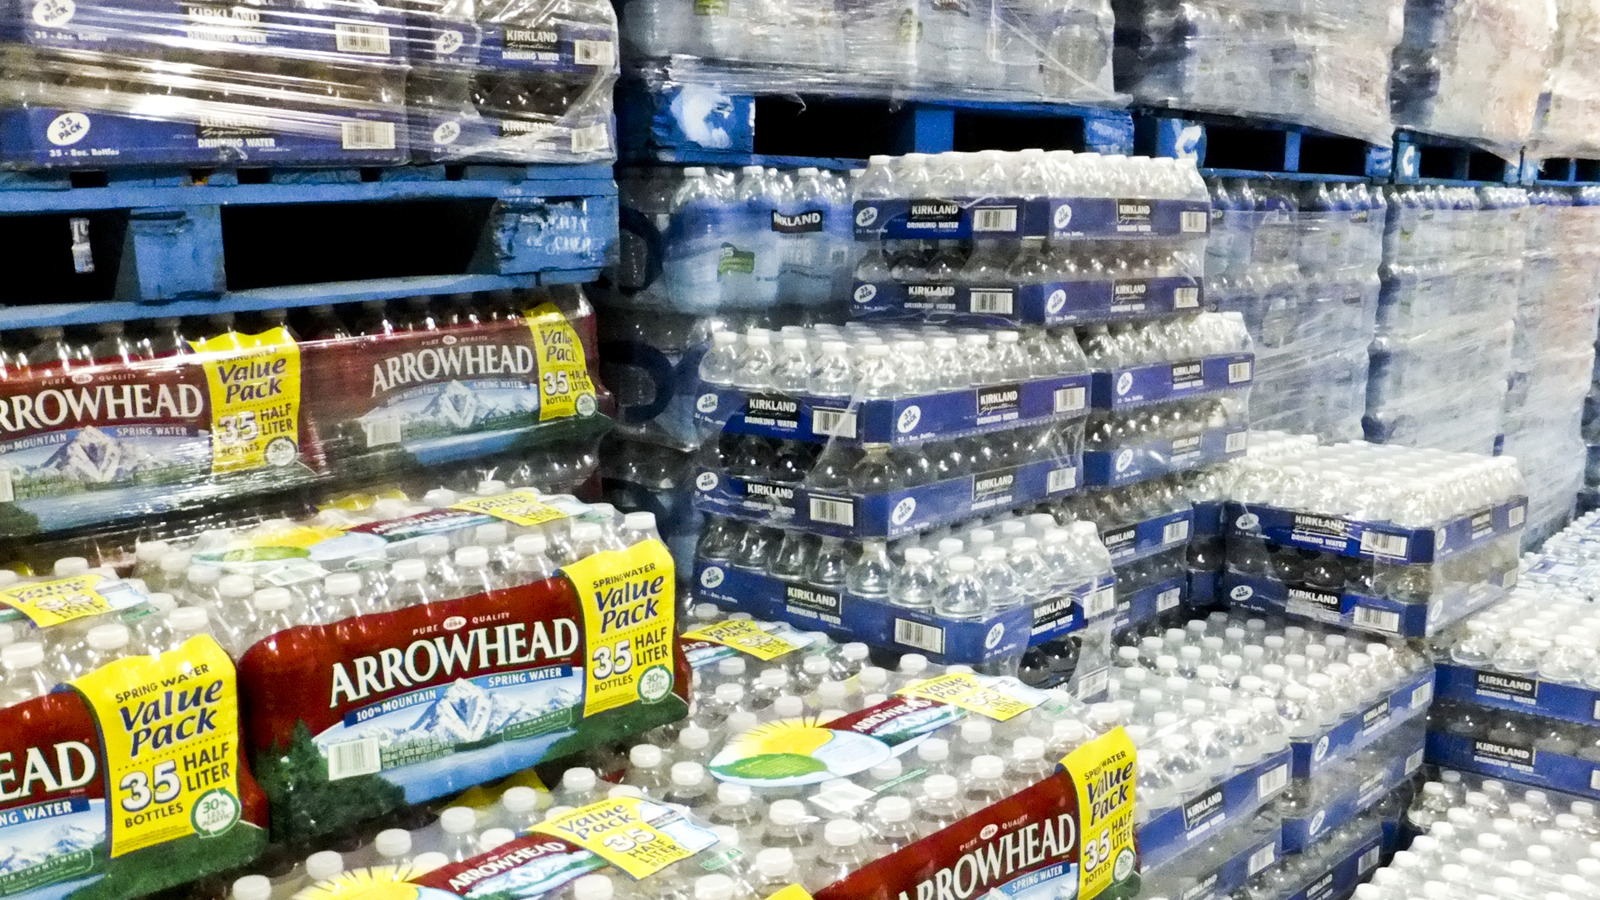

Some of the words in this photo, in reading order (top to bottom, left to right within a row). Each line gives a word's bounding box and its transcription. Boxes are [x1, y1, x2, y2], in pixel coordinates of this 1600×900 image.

[507, 29, 558, 43] KIRKLAND
[502, 51, 536, 61] DRINKING
[538, 52, 560, 62] WATER
[58, 116, 73, 129] 35
[58, 121, 83, 141] PACK
[49, 149, 62, 157] 35
[197, 137, 244, 149] DRINKING
[246, 137, 276, 148] WATER
[911, 204, 959, 216] KIRKLAND
[1119, 204, 1151, 215] KIRKLAND
[906, 221, 937, 229] DRINKING
[938, 221, 959, 229] WATER
[908, 285, 956, 296] KIRKLAND
[1115, 283, 1146, 295] KIRKLAND
[217, 357, 287, 385] Value
[371, 344, 534, 398] ARROWHEAD
[225, 377, 283, 404] Pack
[543, 370, 570, 396] 35
[749, 398, 797, 413] KIRKLAND
[980, 390, 1018, 405] KIRKLAND
[218, 410, 259, 446] 35
[260, 402, 293, 422] HALF
[261, 418, 294, 436] LITER
[744, 416, 775, 427] DRINKING
[777, 419, 798, 429] WATER
[14, 432, 68, 450] MOUNTAIN
[116, 426, 153, 437] SPRING
[155, 425, 188, 436] WATER
[747, 483, 794, 500] KIRKLAND
[976, 474, 1014, 492] KIRKLAND
[1295, 514, 1346, 531] KIRKLAND
[1105, 529, 1136, 546] KIRKLAND
[1290, 533, 1324, 545] DRINKING
[1325, 538, 1348, 549] WATER
[623, 562, 656, 579] WATER
[594, 575, 664, 612] Value
[787, 586, 837, 607] KIRKLAND
[1288, 588, 1339, 605] KIRKLAND
[600, 597, 659, 634] Pack
[820, 611, 842, 625] WATER
[1033, 598, 1072, 619] KIRKLAND
[412, 623, 438, 636] PURE
[472, 611, 511, 625] QUALITY
[329, 616, 580, 708] ARROWHEAD
[592, 638, 633, 681] 35
[635, 626, 668, 650] HALF
[636, 643, 669, 667] LITER
[115, 682, 159, 704] SPRING
[160, 663, 210, 689] WATER
[594, 674, 634, 694] BOTTLES
[917, 676, 965, 696] Value
[1477, 674, 1533, 692] KIRKLAND
[119, 678, 225, 732] Value
[356, 706, 381, 722] 100%
[382, 689, 438, 713] MOUNTAIN
[488, 672, 527, 688] SPRING
[529, 667, 563, 682] WATER
[130, 706, 219, 758] Pack
[1101, 750, 1127, 769] WATER
[1475, 741, 1530, 760] KIRKLAND
[119, 758, 182, 813] 35
[183, 741, 231, 773] HALF
[186, 761, 231, 793] LITER
[1087, 760, 1134, 805] Value
[22, 800, 73, 821] WATER
[124, 802, 184, 829] BOTTLES
[202, 798, 229, 815] 30%
[1090, 783, 1130, 827] Pack
[1186, 791, 1223, 820] KIRKLAND
[556, 803, 629, 835] Value
[574, 812, 638, 842] Pack
[602, 828, 656, 855] 35
[626, 838, 667, 860] HALF
[1084, 827, 1111, 874] 35
[1111, 809, 1133, 836] HALF
[1112, 829, 1131, 851] LITER
[638, 844, 681, 865] LITER
[898, 812, 1076, 900] RROWHEAD
[448, 840, 567, 892] ARROWHEAD
[1084, 860, 1111, 887] BOTTLES
[1012, 874, 1039, 893] SPRING
[1040, 864, 1064, 884] WATER
